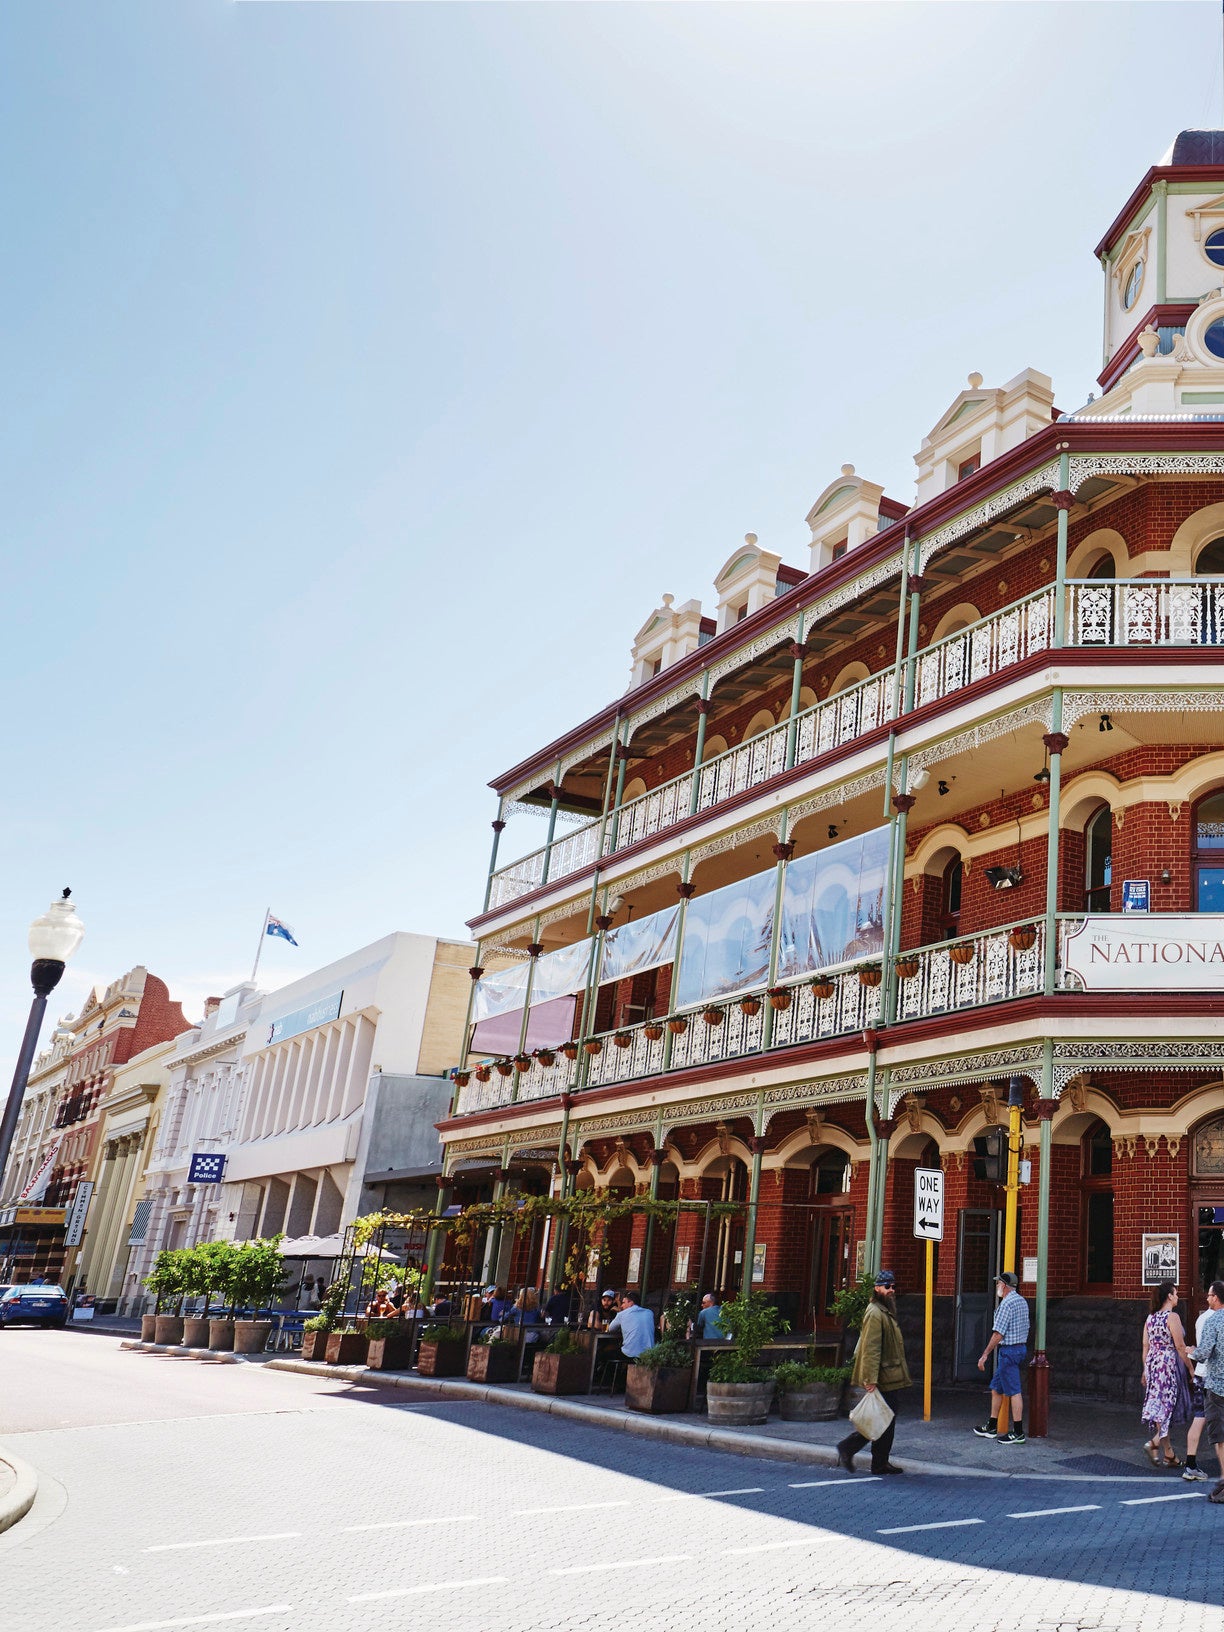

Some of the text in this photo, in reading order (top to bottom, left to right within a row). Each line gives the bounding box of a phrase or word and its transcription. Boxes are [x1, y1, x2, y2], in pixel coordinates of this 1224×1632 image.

[20, 1146, 58, 1199] BACKPACKERS
[919, 1175, 939, 1193] ONE
[918, 1196, 940, 1214] WAY
